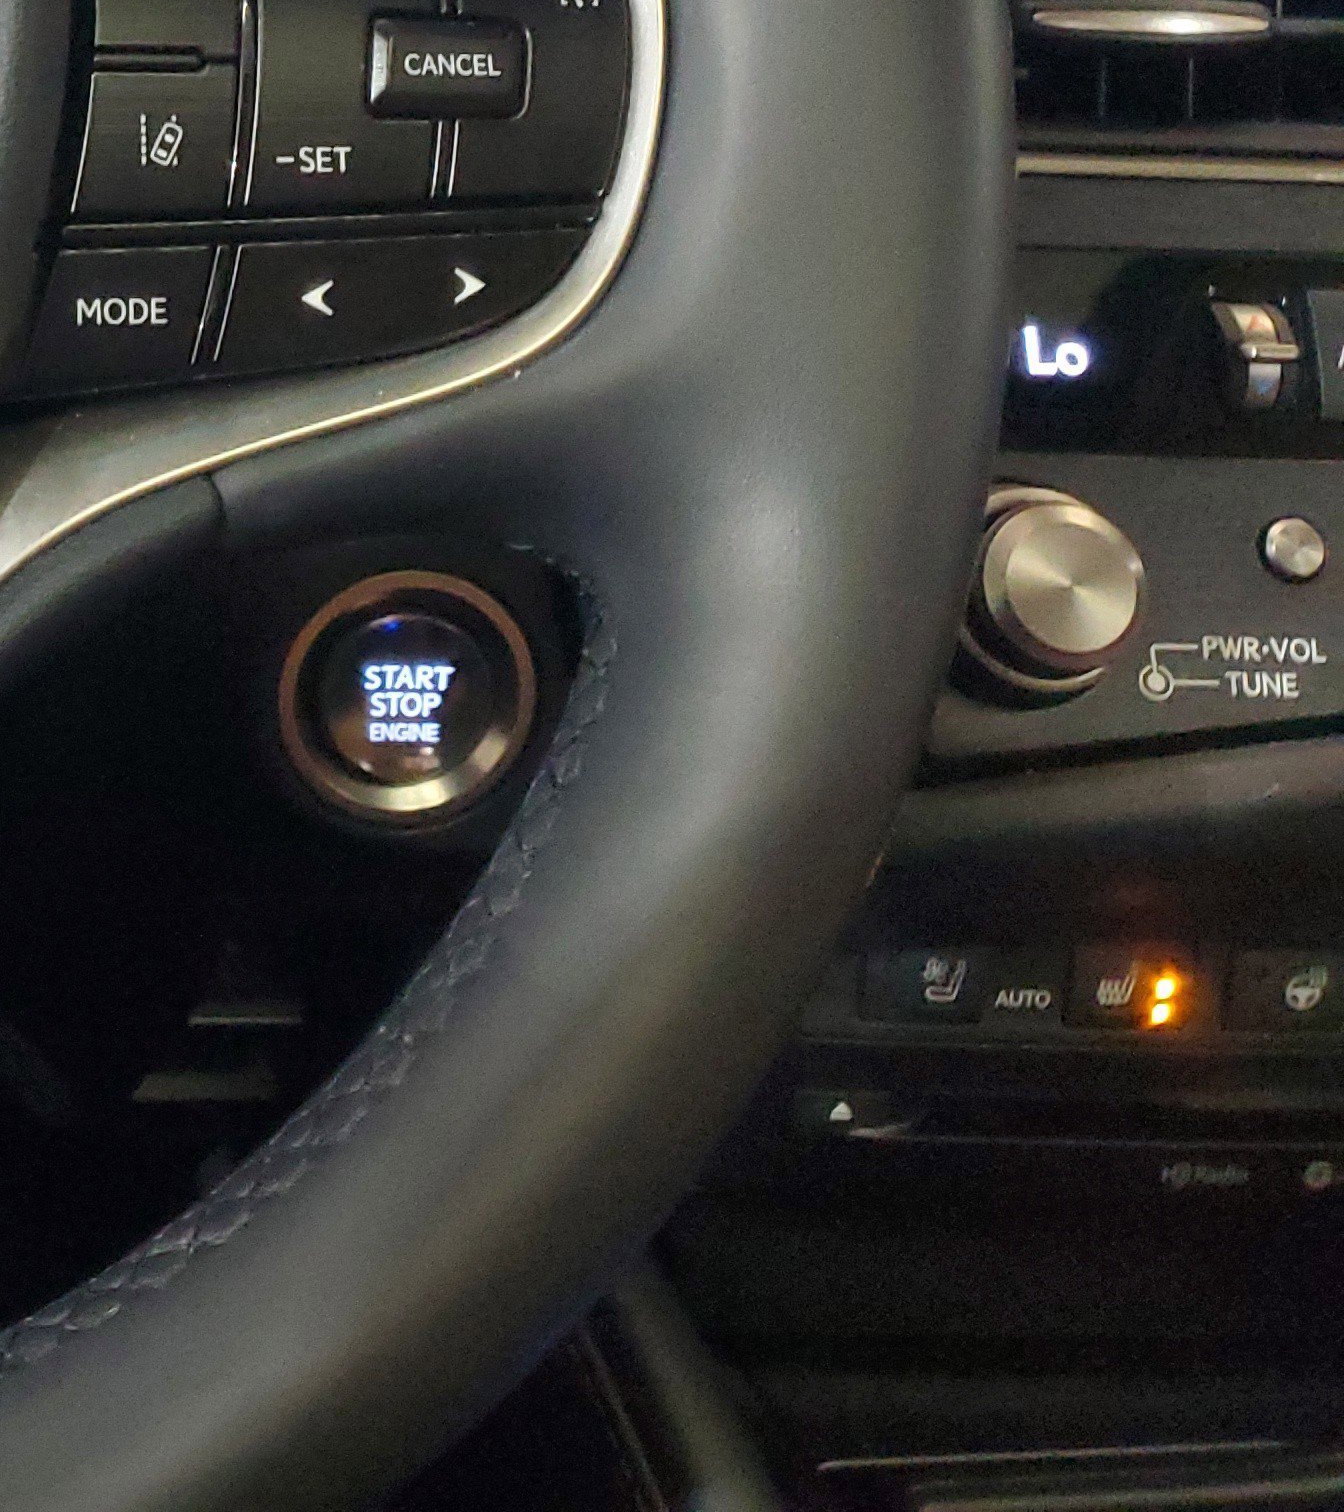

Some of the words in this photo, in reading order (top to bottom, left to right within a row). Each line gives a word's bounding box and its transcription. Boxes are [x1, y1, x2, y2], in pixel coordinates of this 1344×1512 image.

[403, 52, 501, 78] CANCEL
[76, 297, 169, 326] MODE
[1022, 324, 1090, 377] Lo
[363, 664, 457, 692] START
[1224, 670, 1301, 699] TUNE
[369, 692, 443, 718] STOP
[368, 721, 442, 744] ENGINE
[994, 987, 1052, 1012] AUTO
